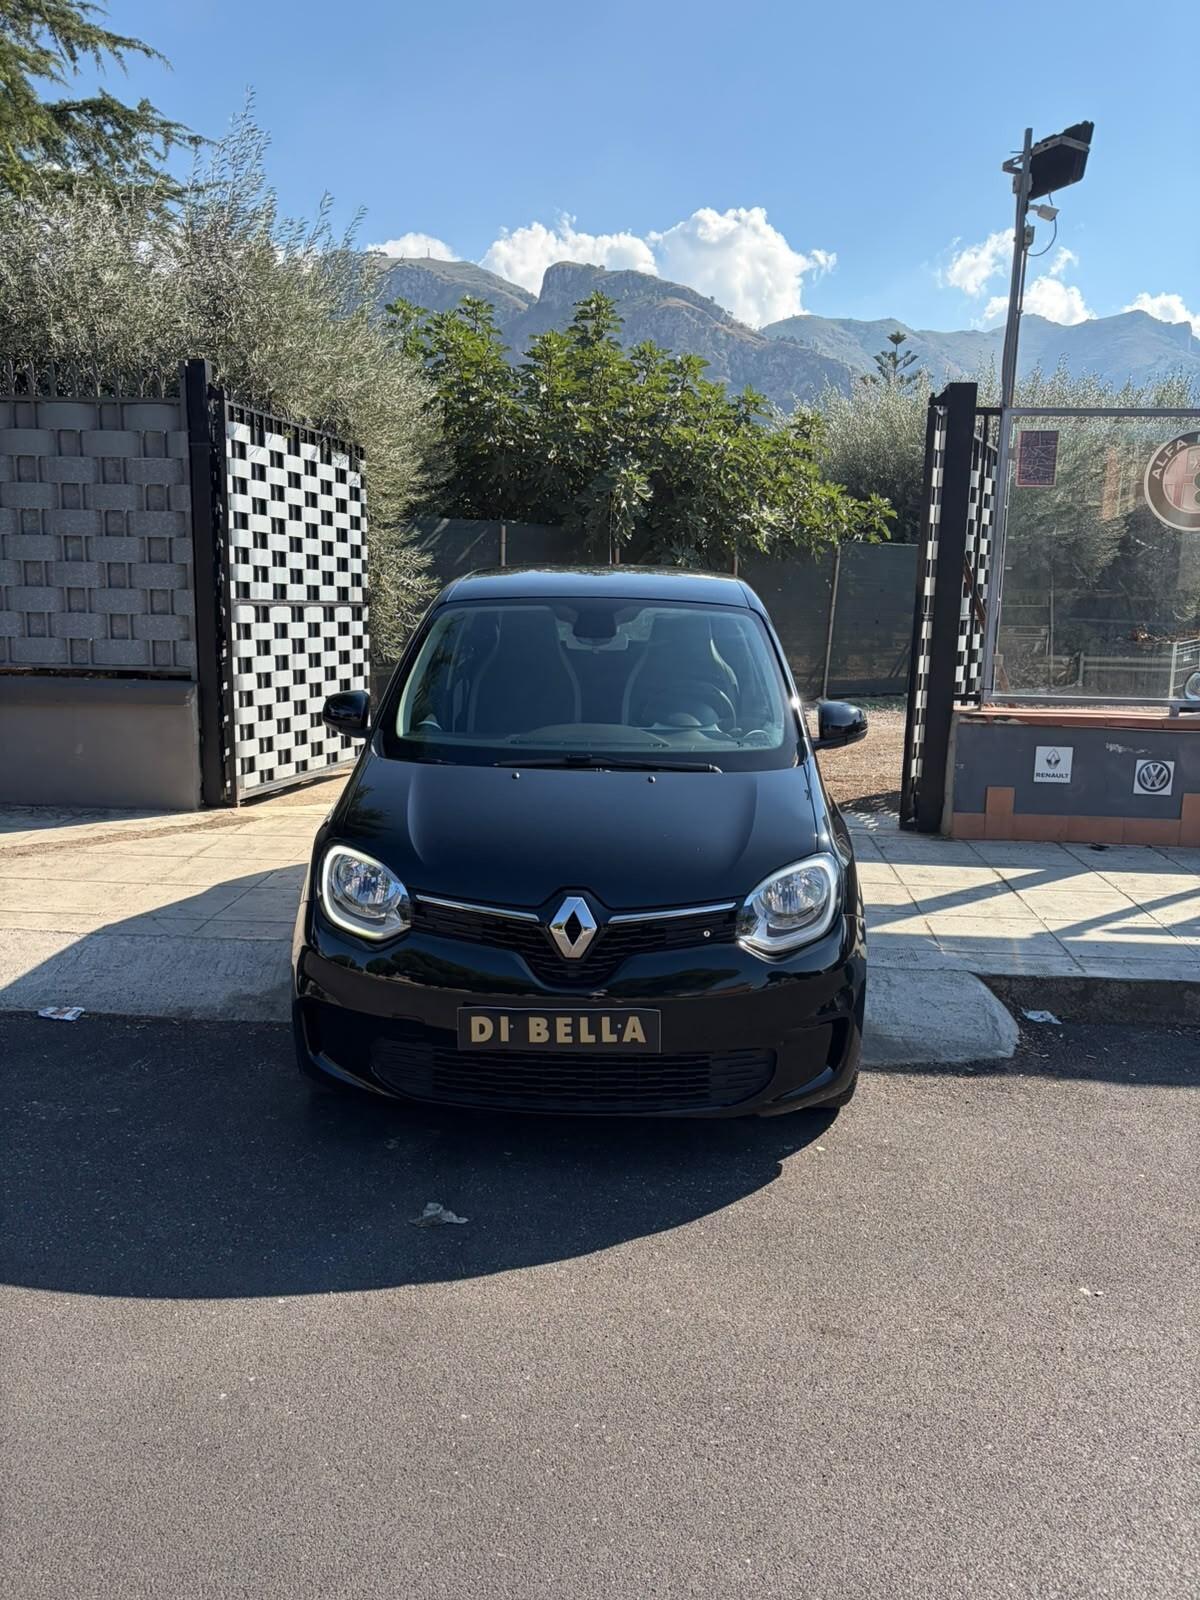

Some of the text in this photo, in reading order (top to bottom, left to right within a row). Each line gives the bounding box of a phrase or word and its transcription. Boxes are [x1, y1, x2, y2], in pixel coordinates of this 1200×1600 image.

[1152, 439, 1188, 480] ALFA
[470, 1016, 647, 1044] DI BELLA
